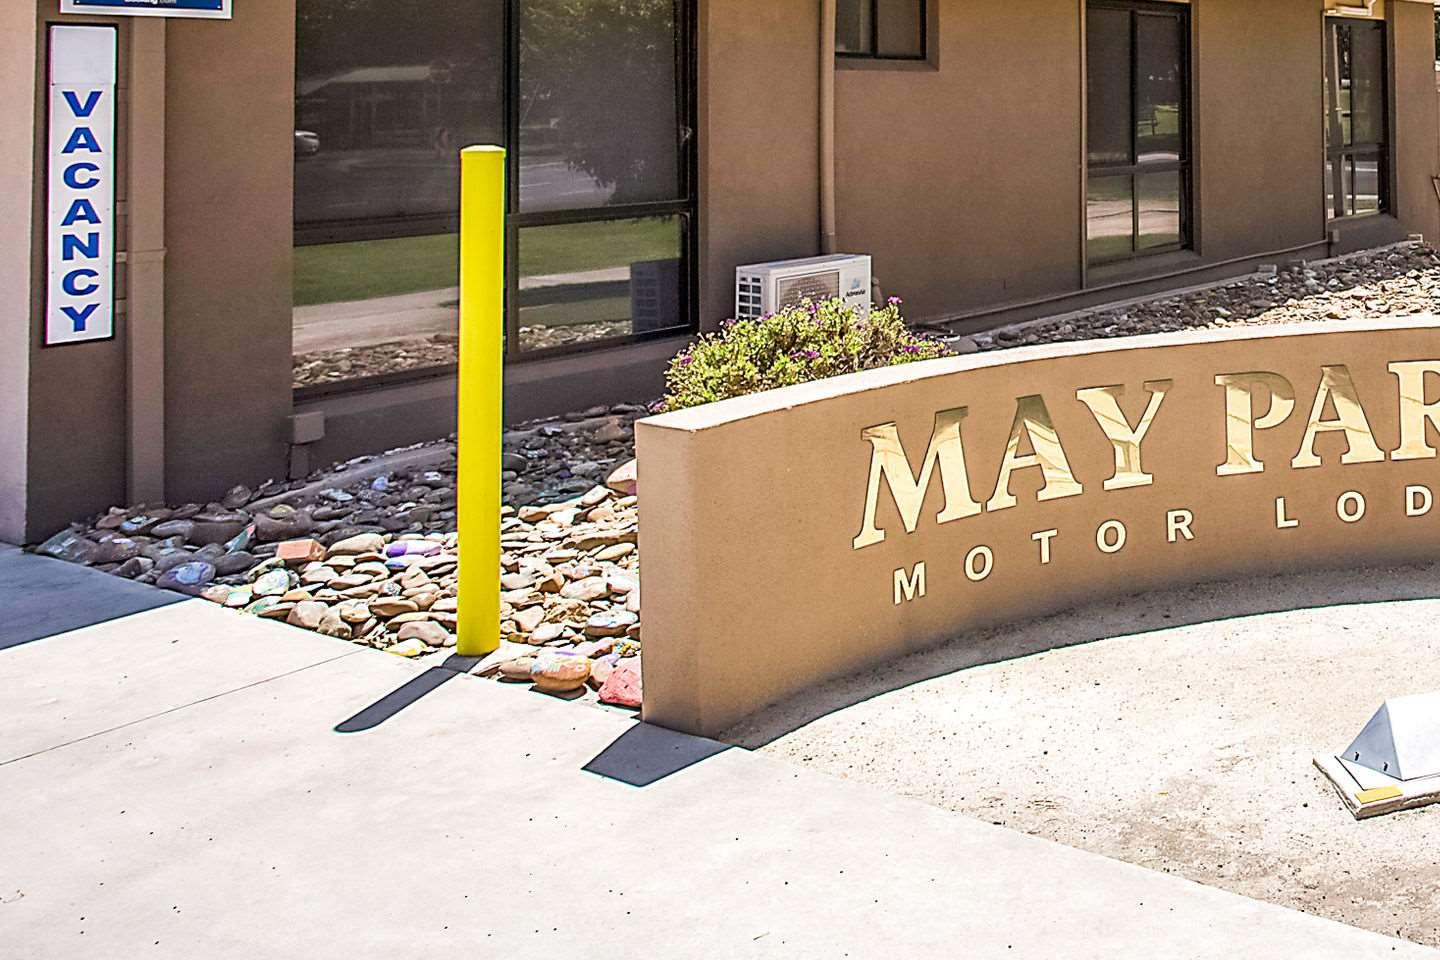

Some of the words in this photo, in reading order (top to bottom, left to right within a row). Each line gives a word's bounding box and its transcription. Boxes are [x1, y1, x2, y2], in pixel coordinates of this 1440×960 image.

[60, 90, 103, 333] VACANCY
[852, 378, 1174, 549] MAY
[892, 509, 1194, 606] MOTOR
